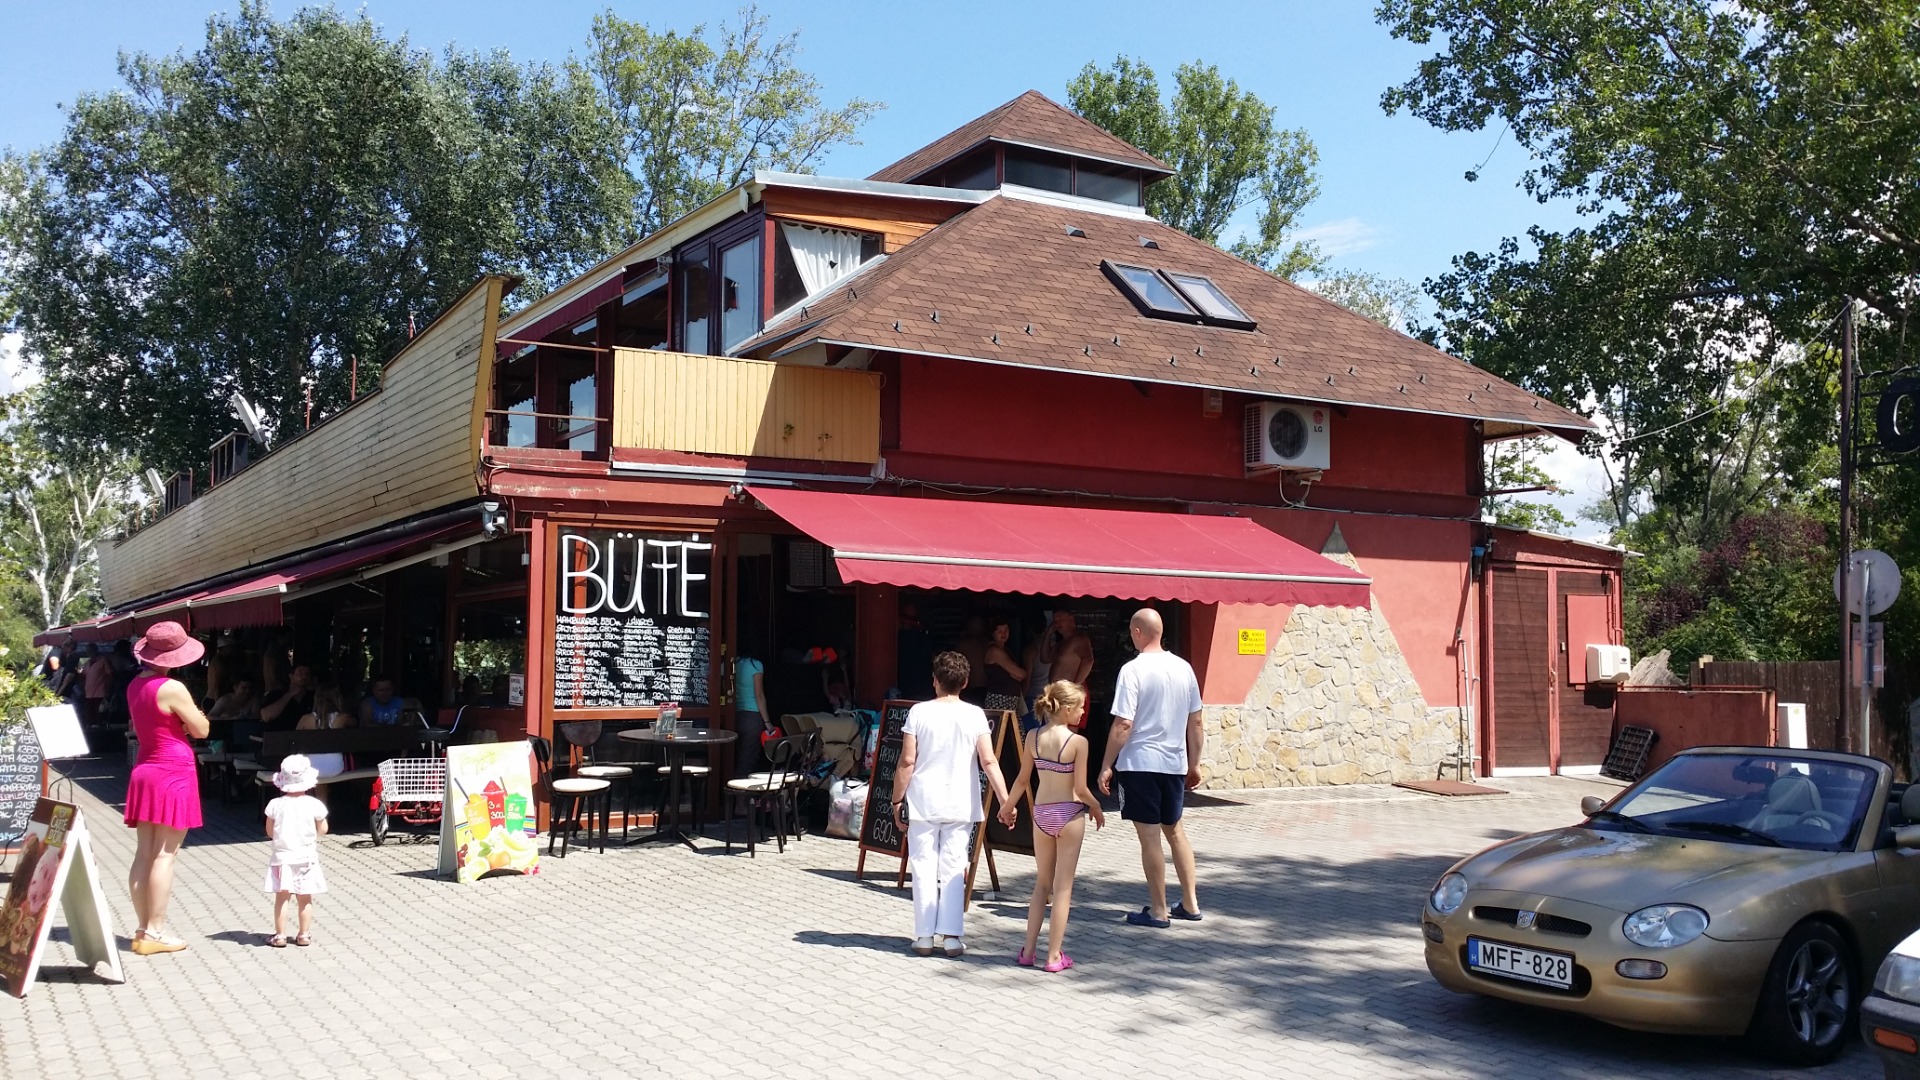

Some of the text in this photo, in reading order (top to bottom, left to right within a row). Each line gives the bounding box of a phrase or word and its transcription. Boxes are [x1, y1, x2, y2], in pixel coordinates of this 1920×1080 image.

[614, 657, 653, 667] PALACSINTA
[668, 657, 690, 668] PIZZA
[1482, 944, 1567, 980] MFF-828
